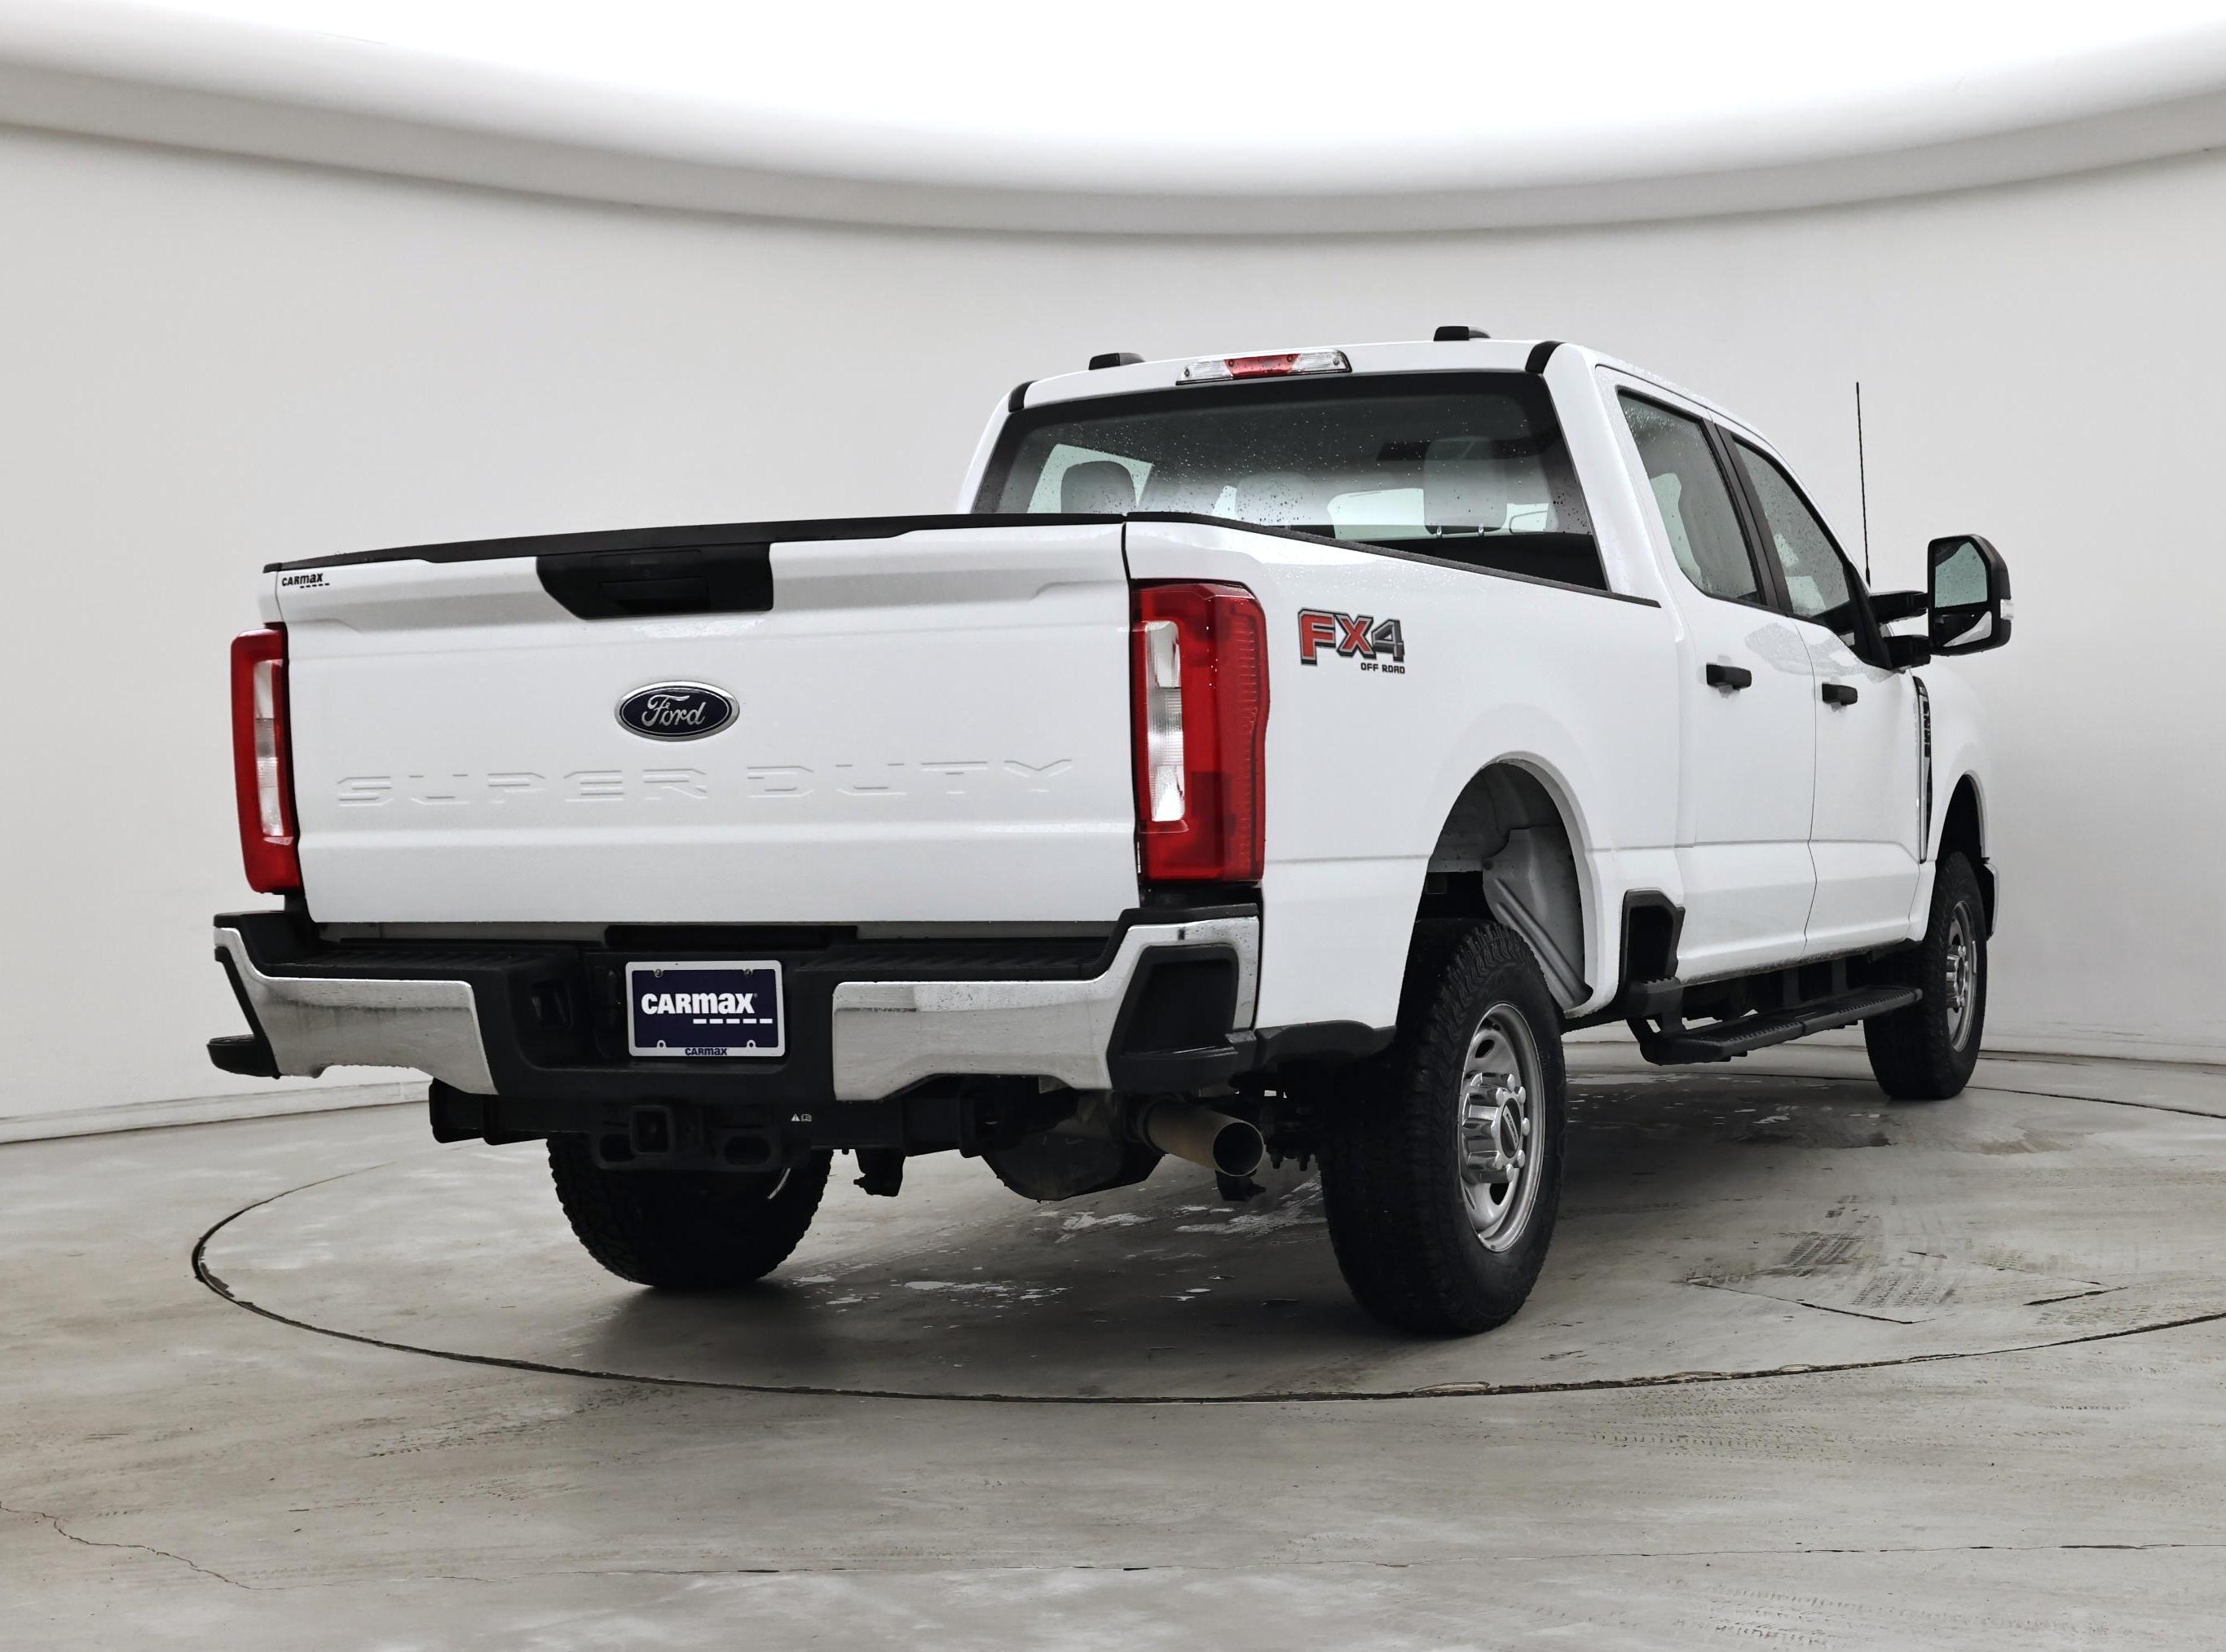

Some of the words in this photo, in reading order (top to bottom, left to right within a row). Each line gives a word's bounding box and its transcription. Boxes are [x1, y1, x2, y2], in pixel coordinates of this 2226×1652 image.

[1298, 607, 1404, 666] FX4
[1360, 662, 1379, 672] OFF
[1382, 664, 1405, 675] ROAD
[641, 694, 707, 727] Ford
[337, 769, 708, 807] SUPER
[747, 759, 1073, 797] DUTY
